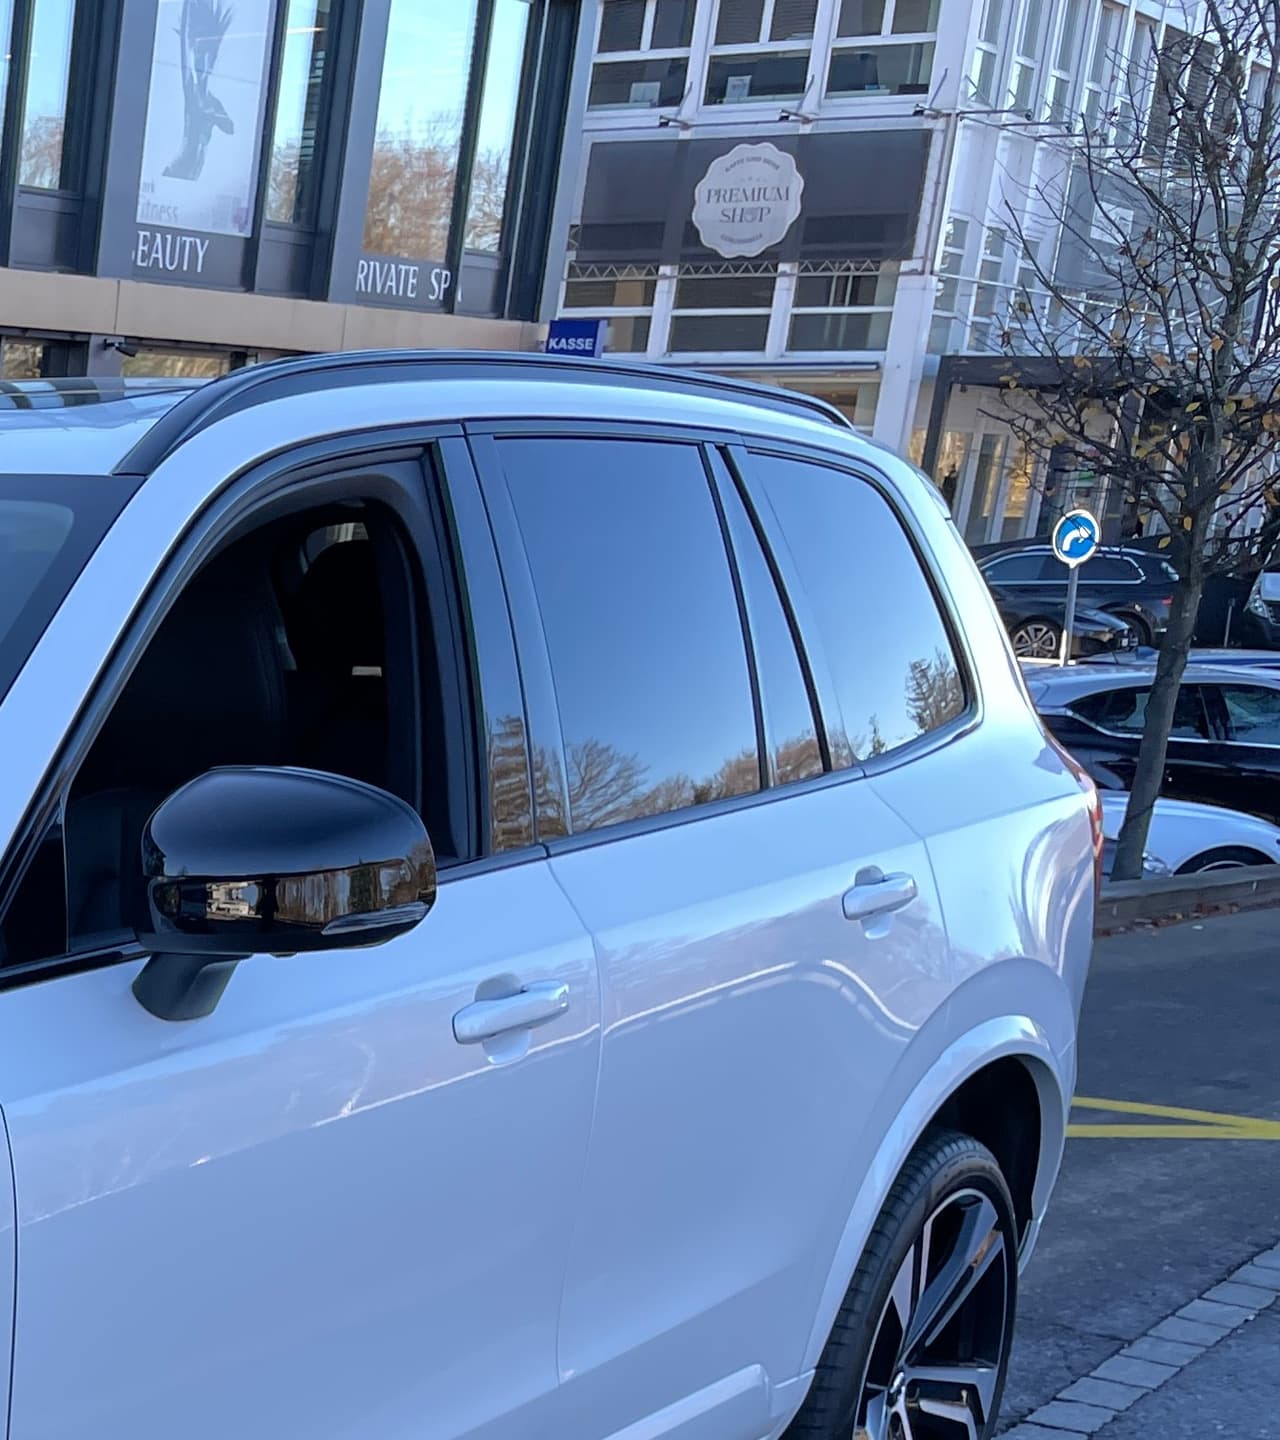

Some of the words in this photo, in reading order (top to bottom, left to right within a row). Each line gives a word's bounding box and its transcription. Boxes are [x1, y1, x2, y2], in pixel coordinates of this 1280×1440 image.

[706, 185, 790, 205] PREMIUM
[131, 230, 210, 273] EAUTY
[354, 259, 420, 299] RIVATE
[427, 268, 463, 302] SP
[547, 337, 595, 351] KASSE
